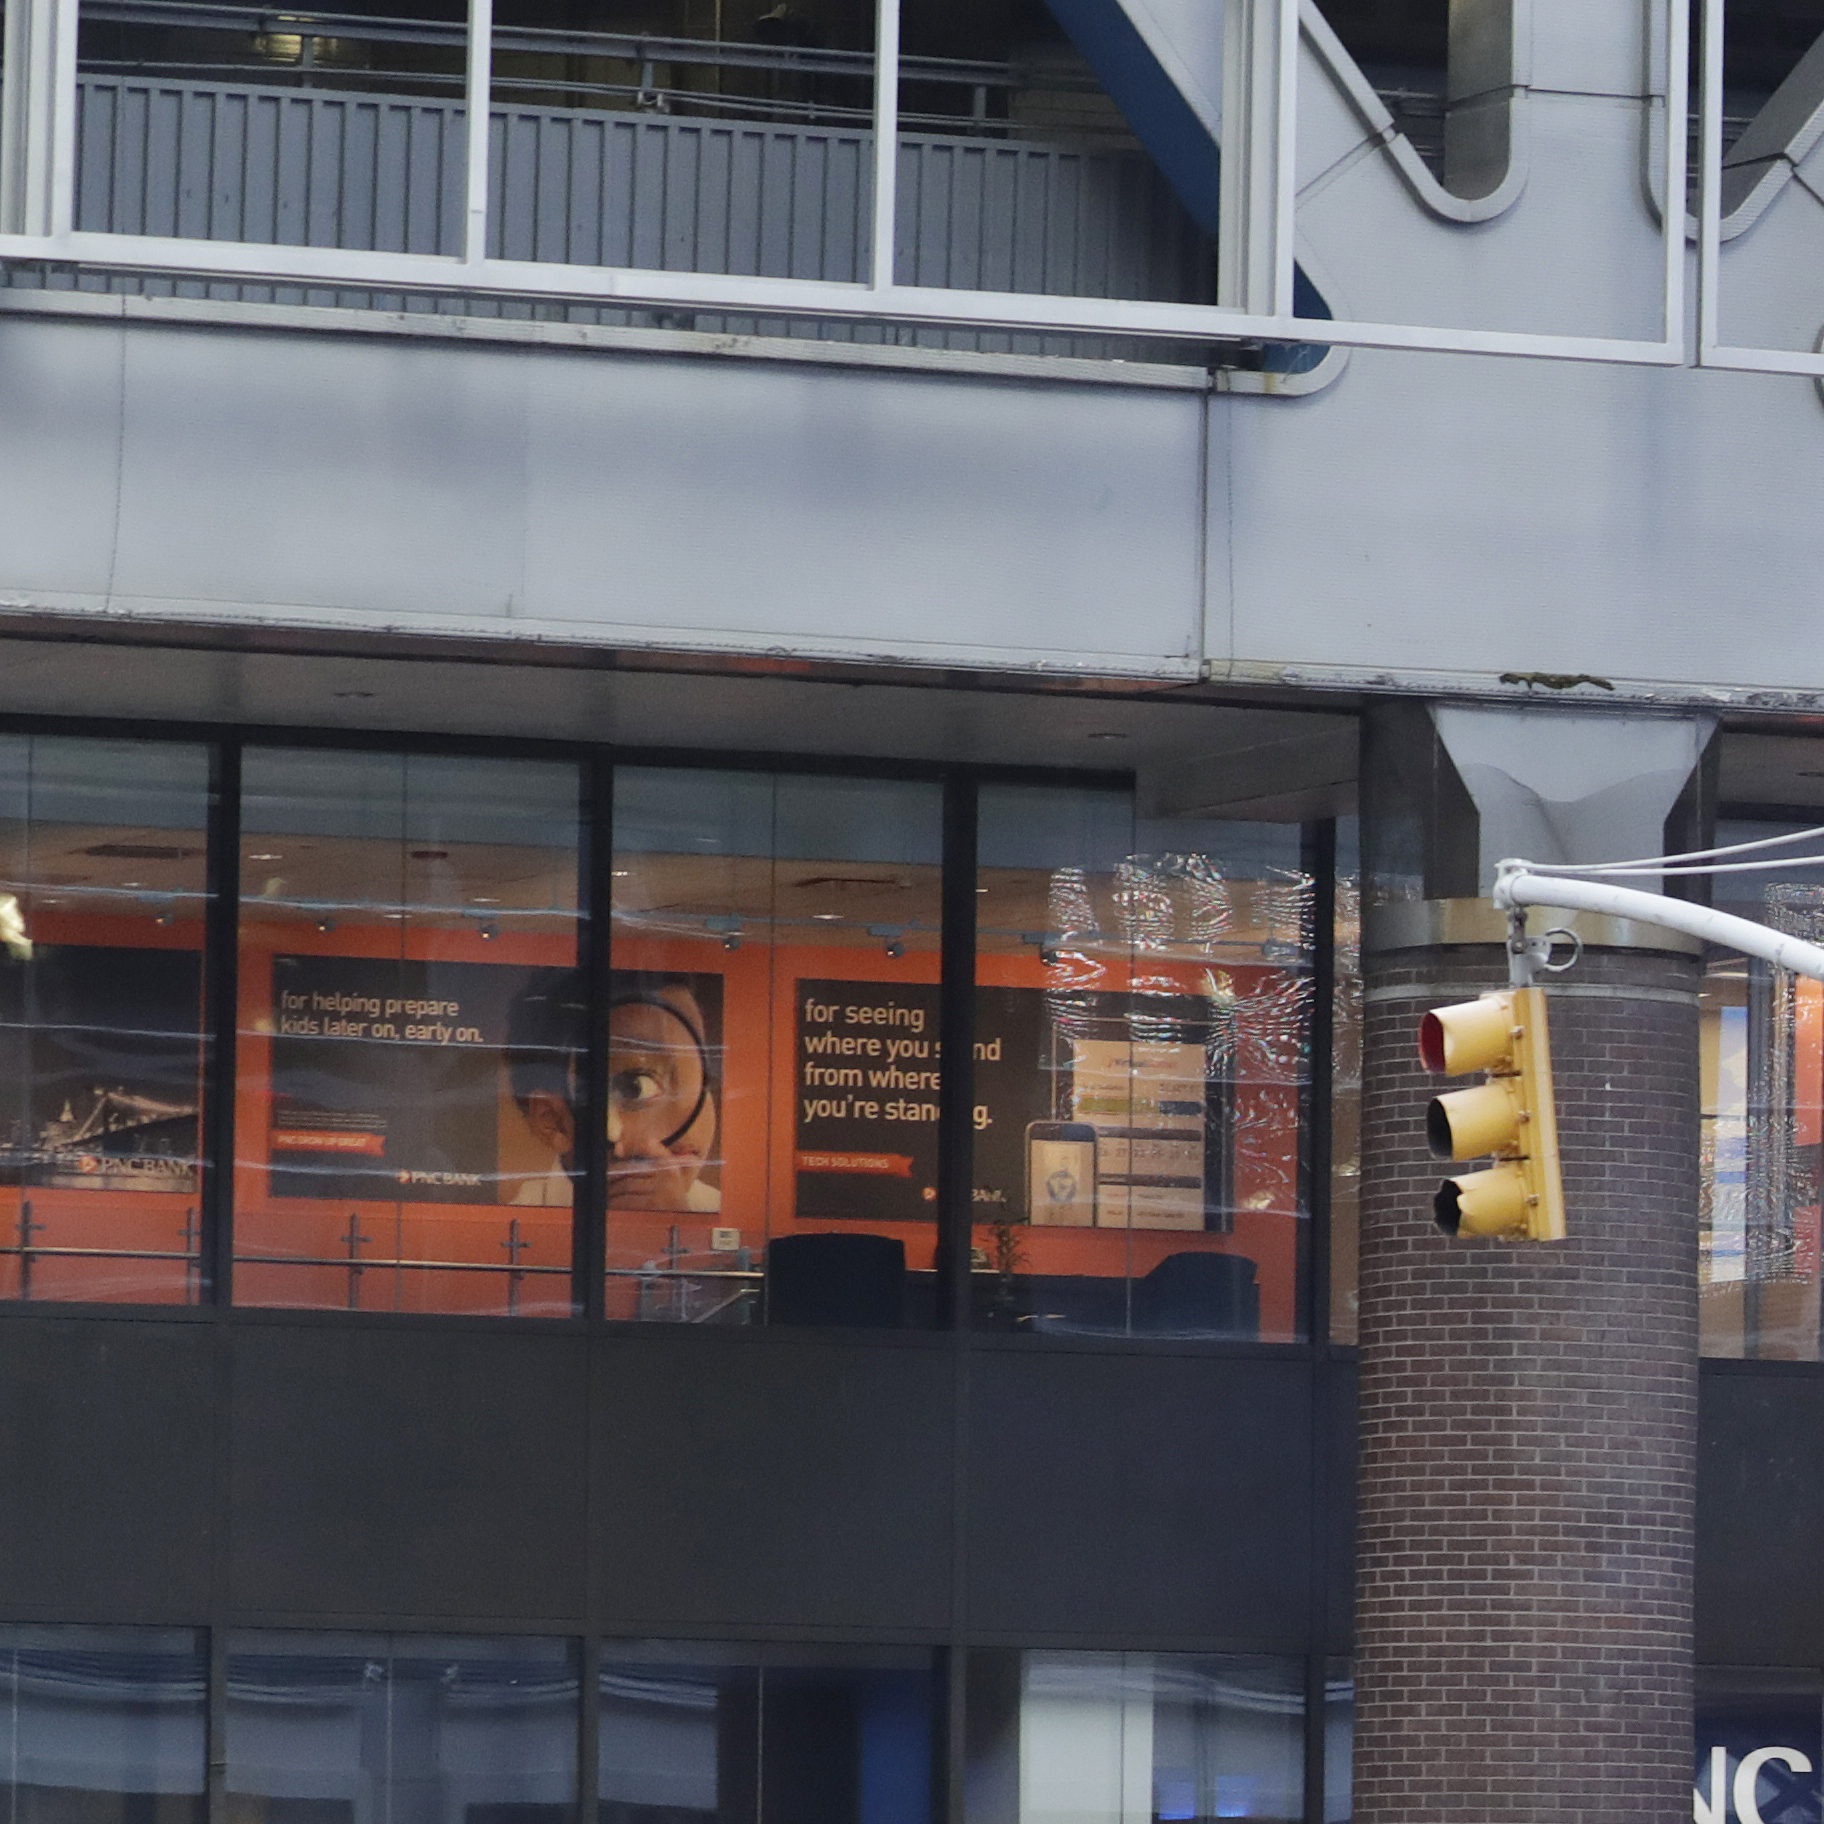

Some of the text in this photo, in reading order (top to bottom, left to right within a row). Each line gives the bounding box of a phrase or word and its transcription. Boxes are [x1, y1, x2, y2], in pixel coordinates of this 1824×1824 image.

[281, 990, 459, 1019] for helping prepare
[805, 999, 925, 1032] for seeing
[281, 1015, 318, 1035] kids
[323, 1017, 365, 1037] later
[405, 1022, 450, 1045] early
[804, 1030, 881, 1056] where
[886, 1039, 929, 1062] you
[804, 1061, 863, 1087] from
[412, 1171, 442, 1184] PNC
